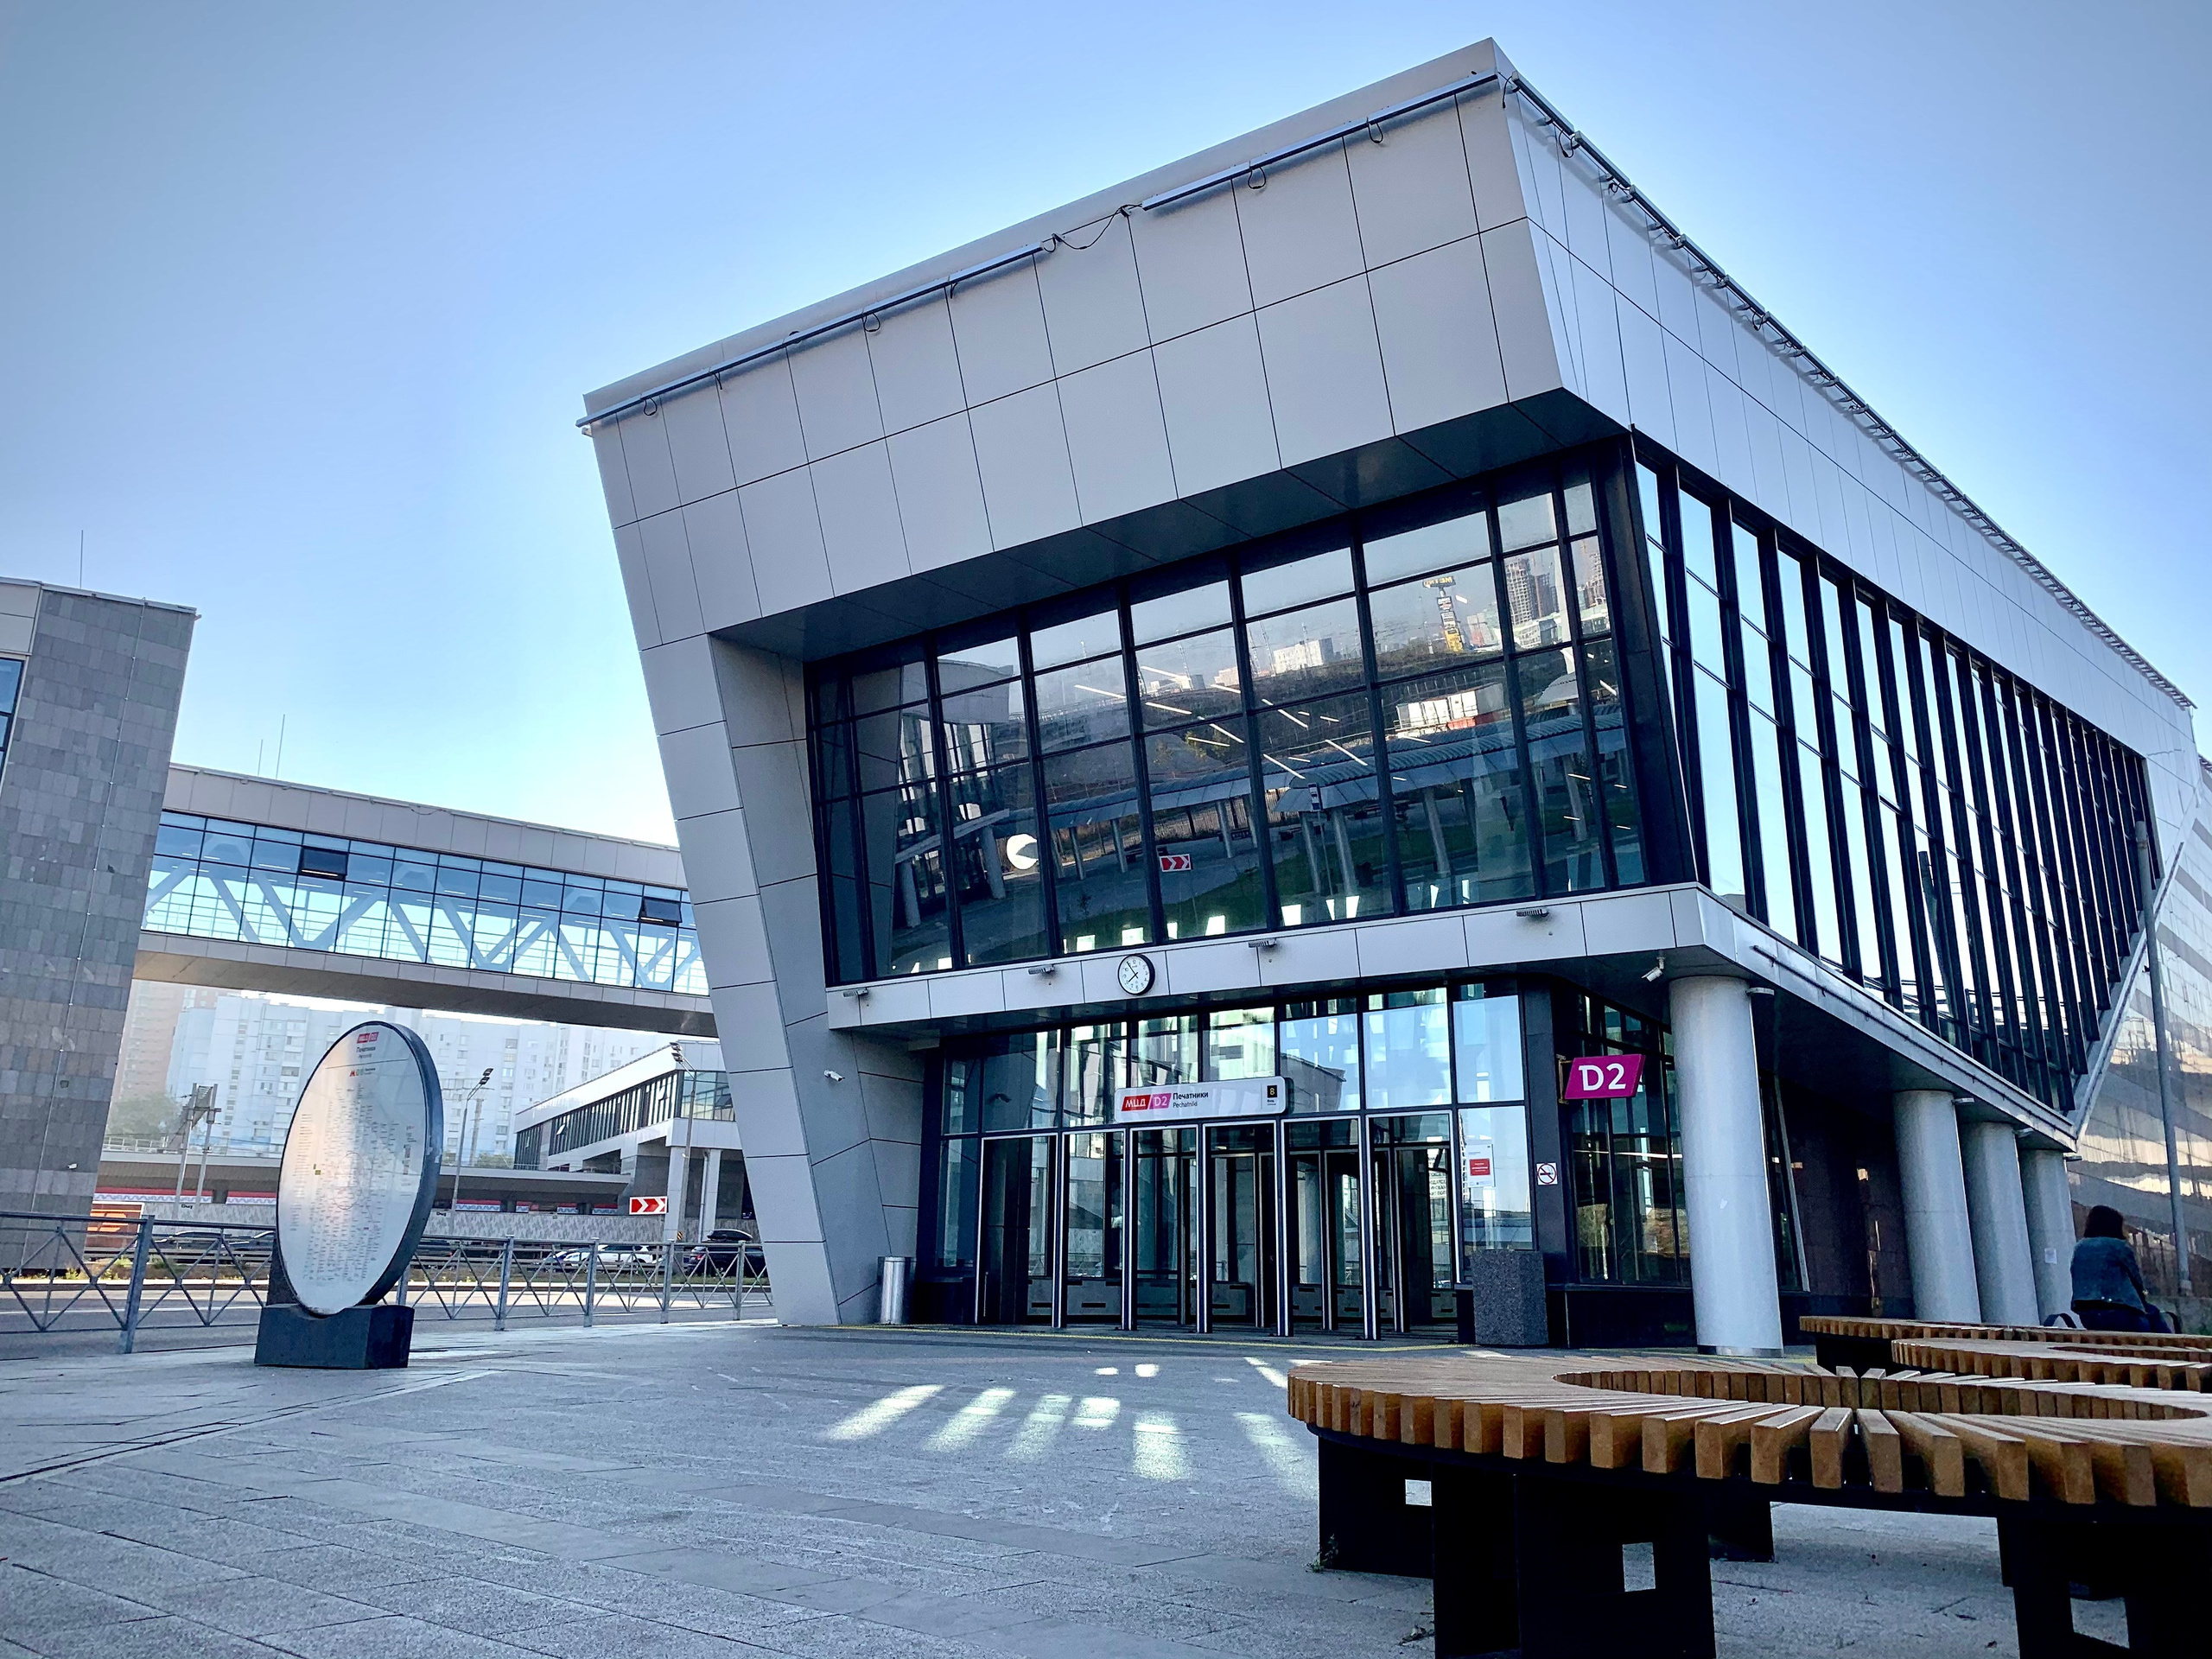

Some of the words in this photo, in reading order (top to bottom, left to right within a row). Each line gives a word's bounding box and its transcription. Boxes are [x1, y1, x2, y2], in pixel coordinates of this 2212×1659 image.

[1578, 1063, 1627, 1091] D2
[1173, 1092, 1209, 1101] Печатники
[1269, 1087, 1275, 1096] 8
[1125, 1097, 1146, 1108] МЦД
[1154, 1096, 1167, 1106] D2
